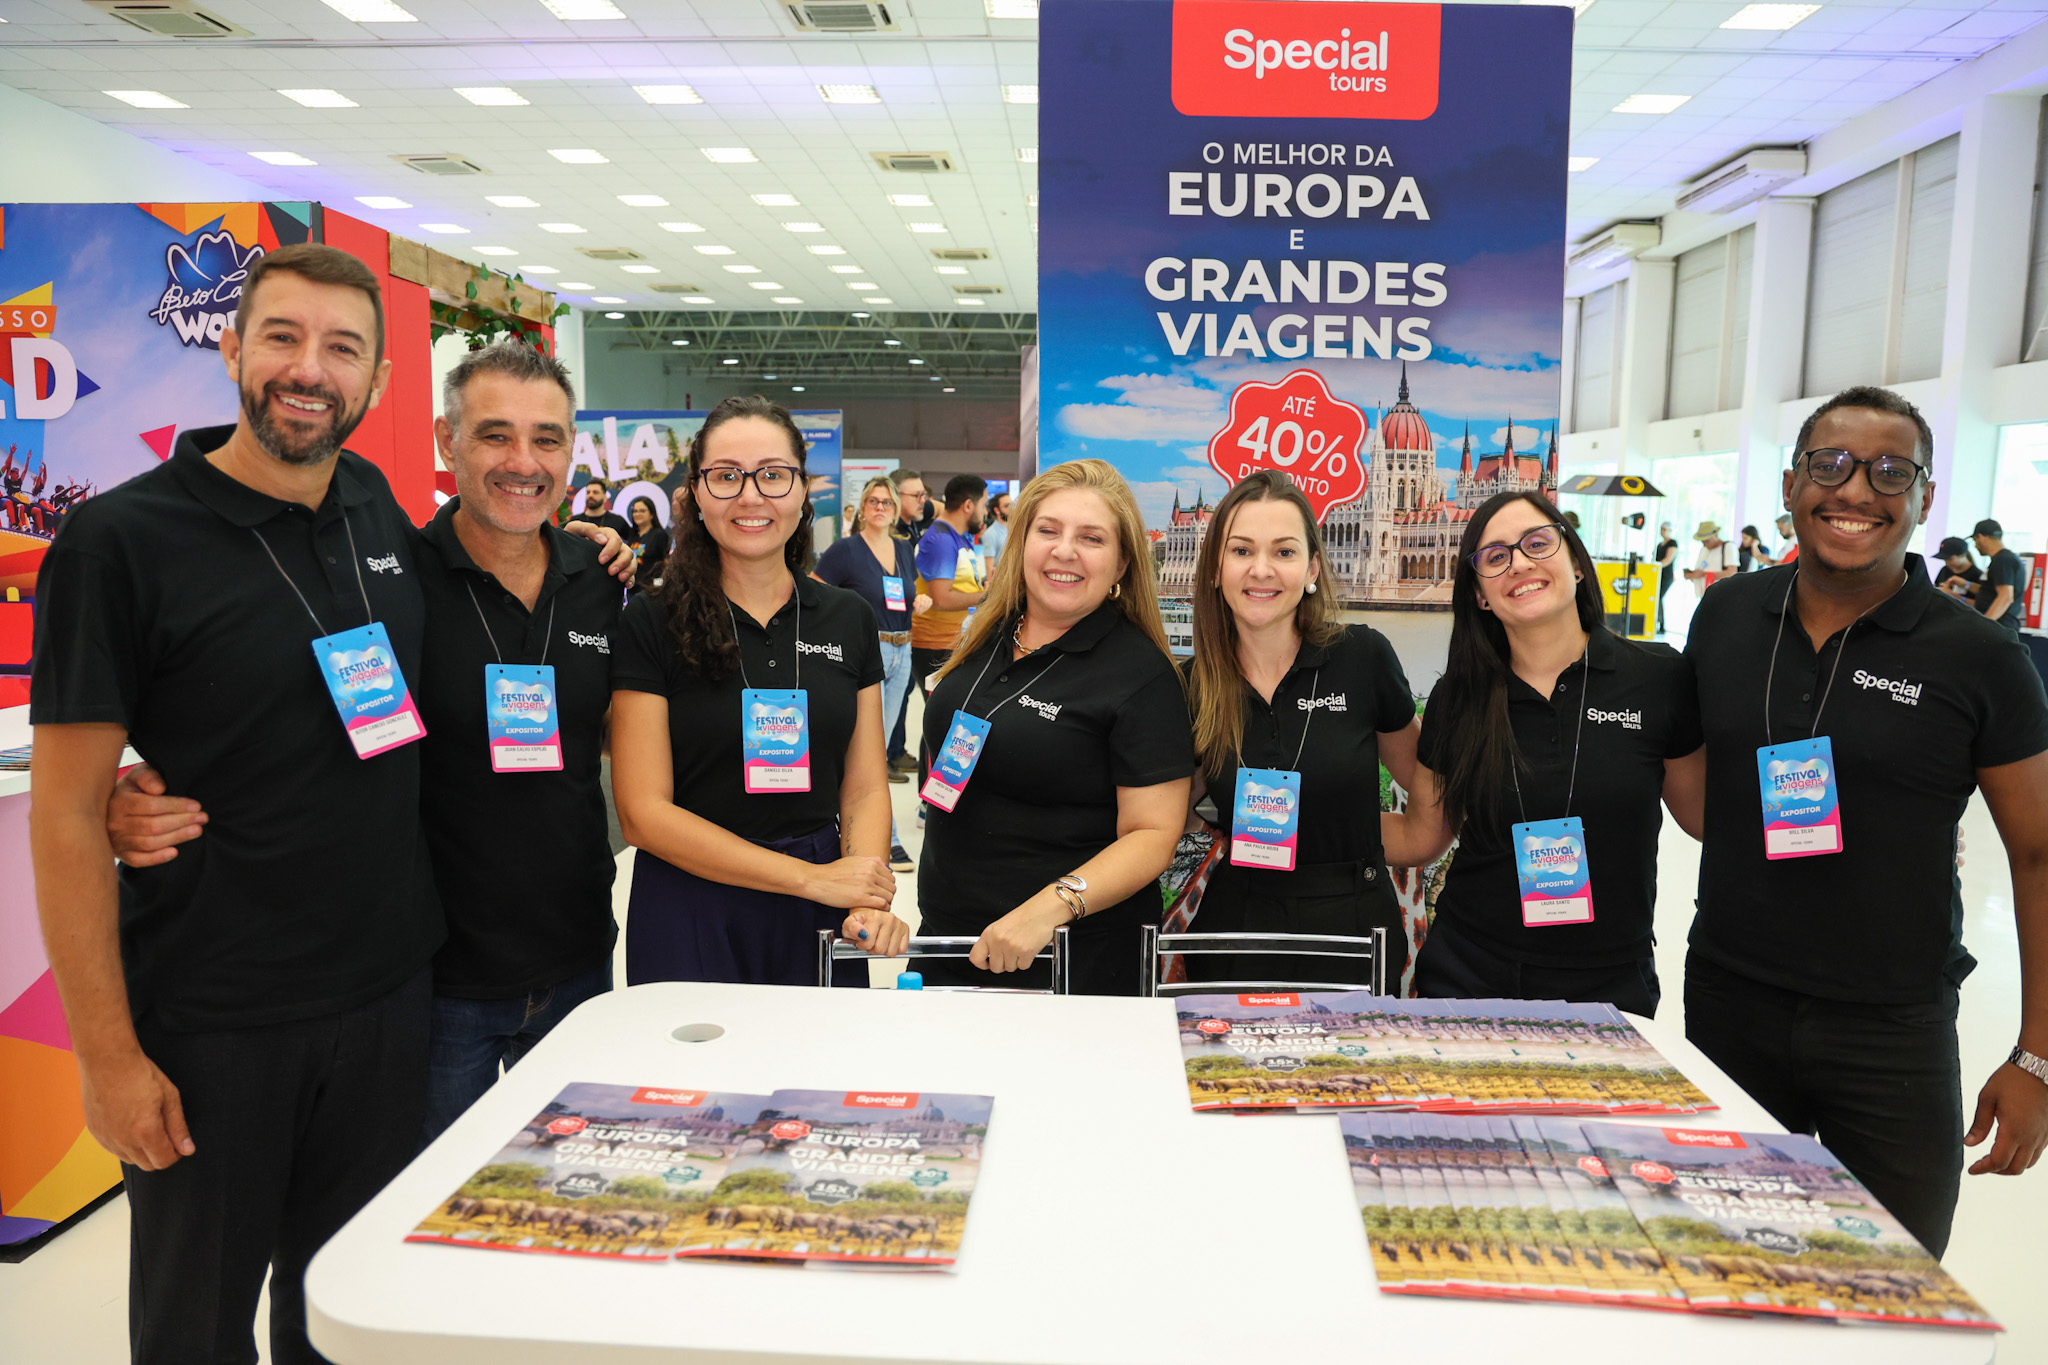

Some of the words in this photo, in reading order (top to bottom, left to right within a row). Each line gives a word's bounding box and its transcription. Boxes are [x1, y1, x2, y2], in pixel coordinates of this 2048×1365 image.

[1224, 28, 1388, 79] Special
[1329, 72, 1387, 92] tours
[1203, 143, 1224, 165] O
[1234, 144, 1346, 166] MELHOR
[1355, 145, 1394, 167] DA
[1168, 172, 1430, 220] EUROPA
[1290, 229, 1304, 250] E
[1144, 257, 1448, 307] GRANDES
[150, 283, 213, 324] Beto
[169, 309, 240, 345] WO
[1157, 312, 1433, 361] VIAGENS
[0, 337, 78, 420] D
[1281, 396, 1316, 418] ATÉ
[1237, 415, 1347, 478] 40%
[367, 553, 399, 574] Special
[568, 631, 608, 647] Special
[795, 641, 842, 656] Special
[1853, 669, 1922, 699] Special
[356, 694, 394, 712] EXPOSITOR
[1018, 694, 1062, 716] Special
[1297, 693, 1346, 712] Special
[1892, 692, 1917, 706] tours
[1039, 710, 1056, 721] tours
[1587, 708, 1641, 724] Special
[1780, 806, 1820, 817] EXPOSITOR
[1247, 826, 1282, 834] EXPOSITOR
[1536, 880, 1574, 888] EXPOSITOR
[1248, 997, 1290, 1005] Special
[1232, 1027, 1328, 1035] EUROPA
[1226, 1036, 1340, 1046] GRANDES
[1233, 1044, 1338, 1054] VIAGENS
[645, 1091, 695, 1101] Special
[856, 1095, 907, 1105] Special
[578, 1129, 688, 1146] EUROPA
[806, 1133, 921, 1149] EUROPA
[1676, 1132, 1732, 1145] Special
[555, 1142, 688, 1163] GRANDES
[788, 1147, 926, 1166] GRANDES
[554, 1154, 673, 1172] VIAGENS
[790, 1158, 915, 1177] VIAGENS
[1676, 1177, 1807, 1196] EUROPA
[1680, 1193, 1831, 1213] GRANDES
[1694, 1206, 1836, 1225] VIAGENS
